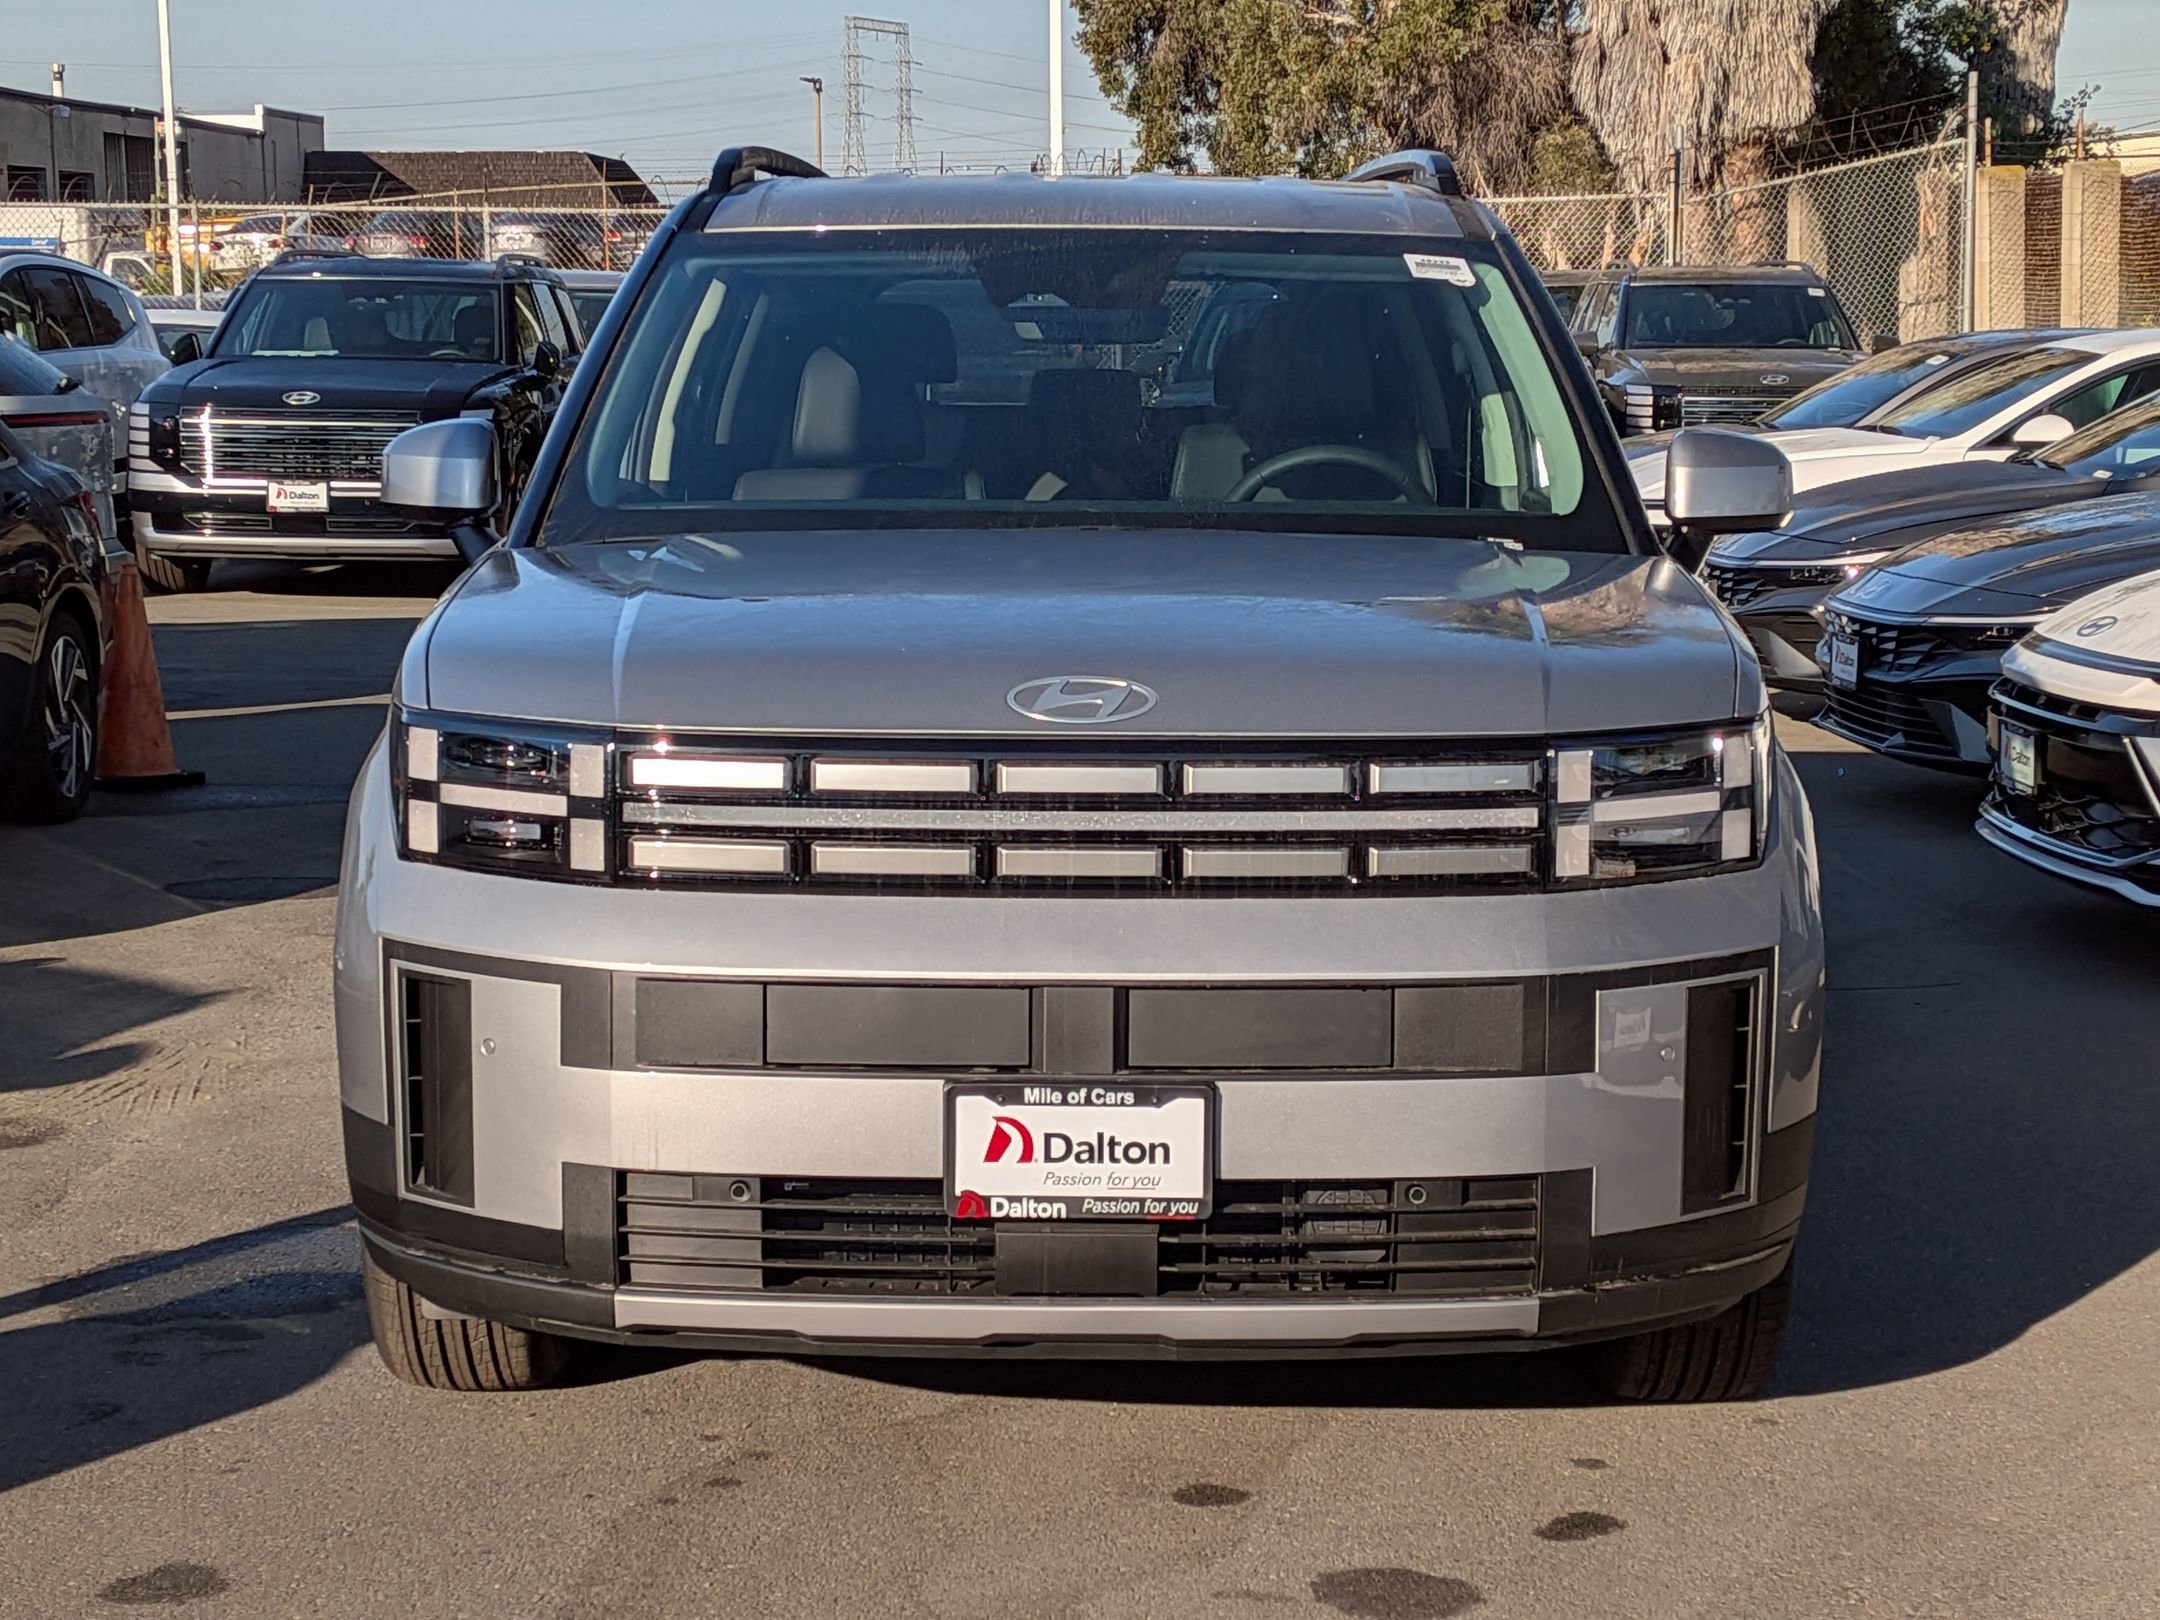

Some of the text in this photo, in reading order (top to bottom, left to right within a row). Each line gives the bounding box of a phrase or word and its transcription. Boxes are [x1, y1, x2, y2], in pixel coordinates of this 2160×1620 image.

[1023, 1087, 1135, 1105] Mile of Cars
[1043, 1131, 1171, 1165] Dalton
[1043, 1171, 1162, 1189] Passion for you
[990, 1197, 1067, 1219] Dalton
[1082, 1198, 1199, 1216] Passion for you
